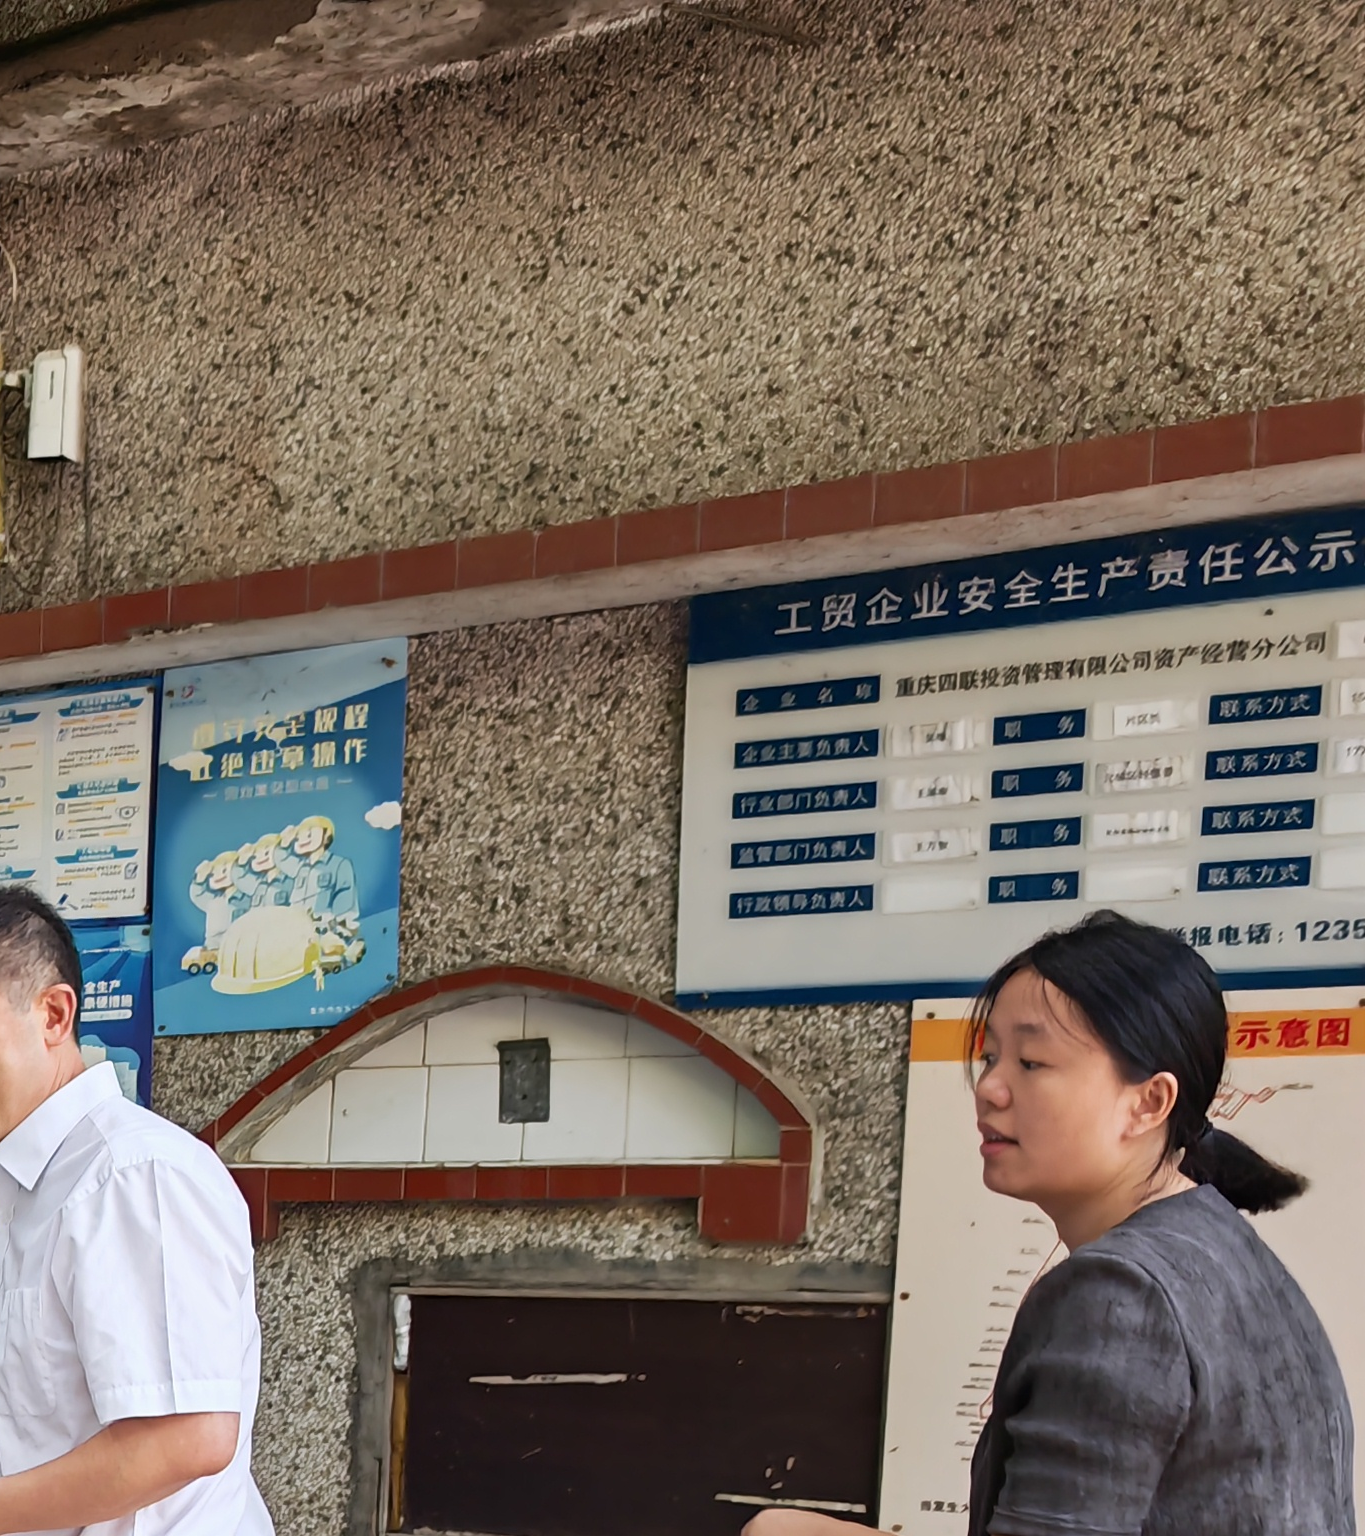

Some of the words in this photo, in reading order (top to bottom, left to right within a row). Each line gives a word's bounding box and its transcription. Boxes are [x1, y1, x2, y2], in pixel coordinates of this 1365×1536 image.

[774, 528, 1365, 638] 工贸企业安全生产责任公示
[895, 630, 1328, 698] 重庆四联投资管理有限公司资产经营分公司
[1235, 1017, 1351, 1050] 示意图
